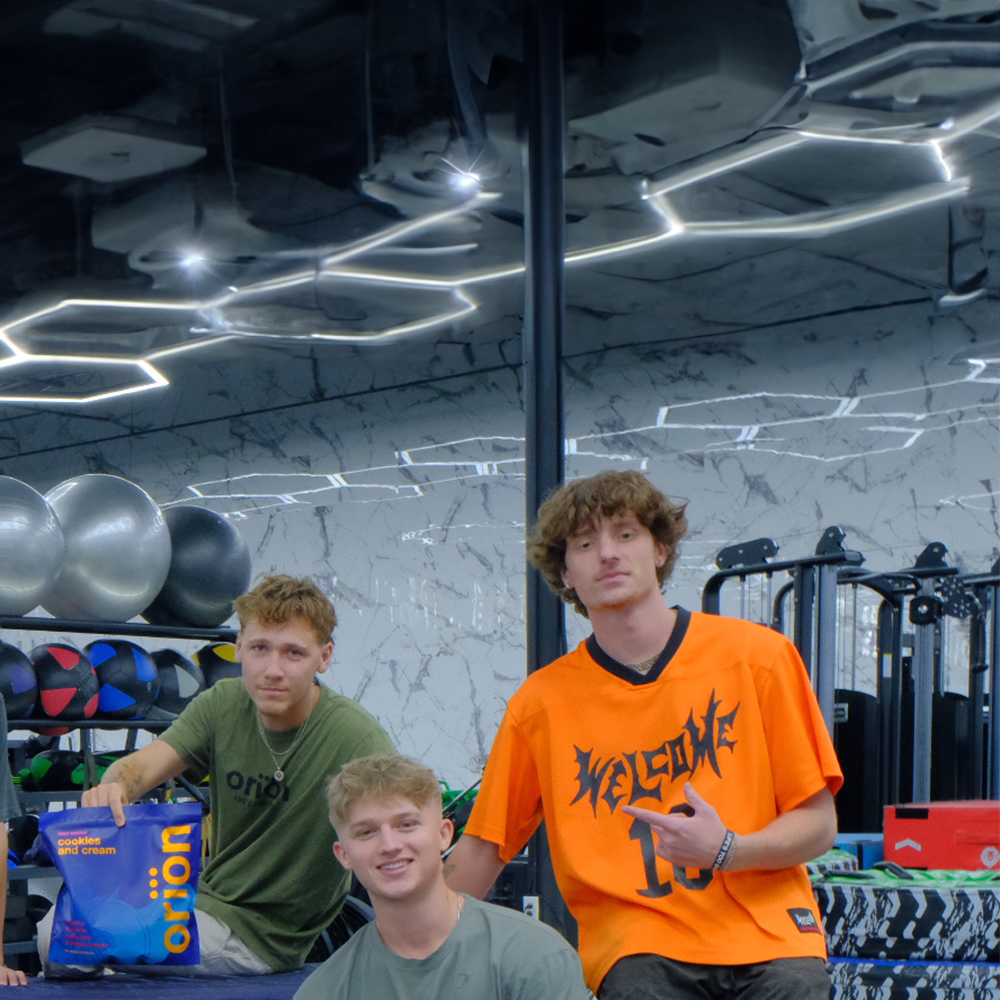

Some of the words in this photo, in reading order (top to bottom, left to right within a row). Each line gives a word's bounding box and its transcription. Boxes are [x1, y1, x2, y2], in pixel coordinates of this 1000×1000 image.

[569, 688, 741, 819] WELCOME
[58, 836, 102, 846] cookies
[58, 845, 79, 855] and
[81, 847, 117, 855] cream
[149, 825, 191, 954] oriön
